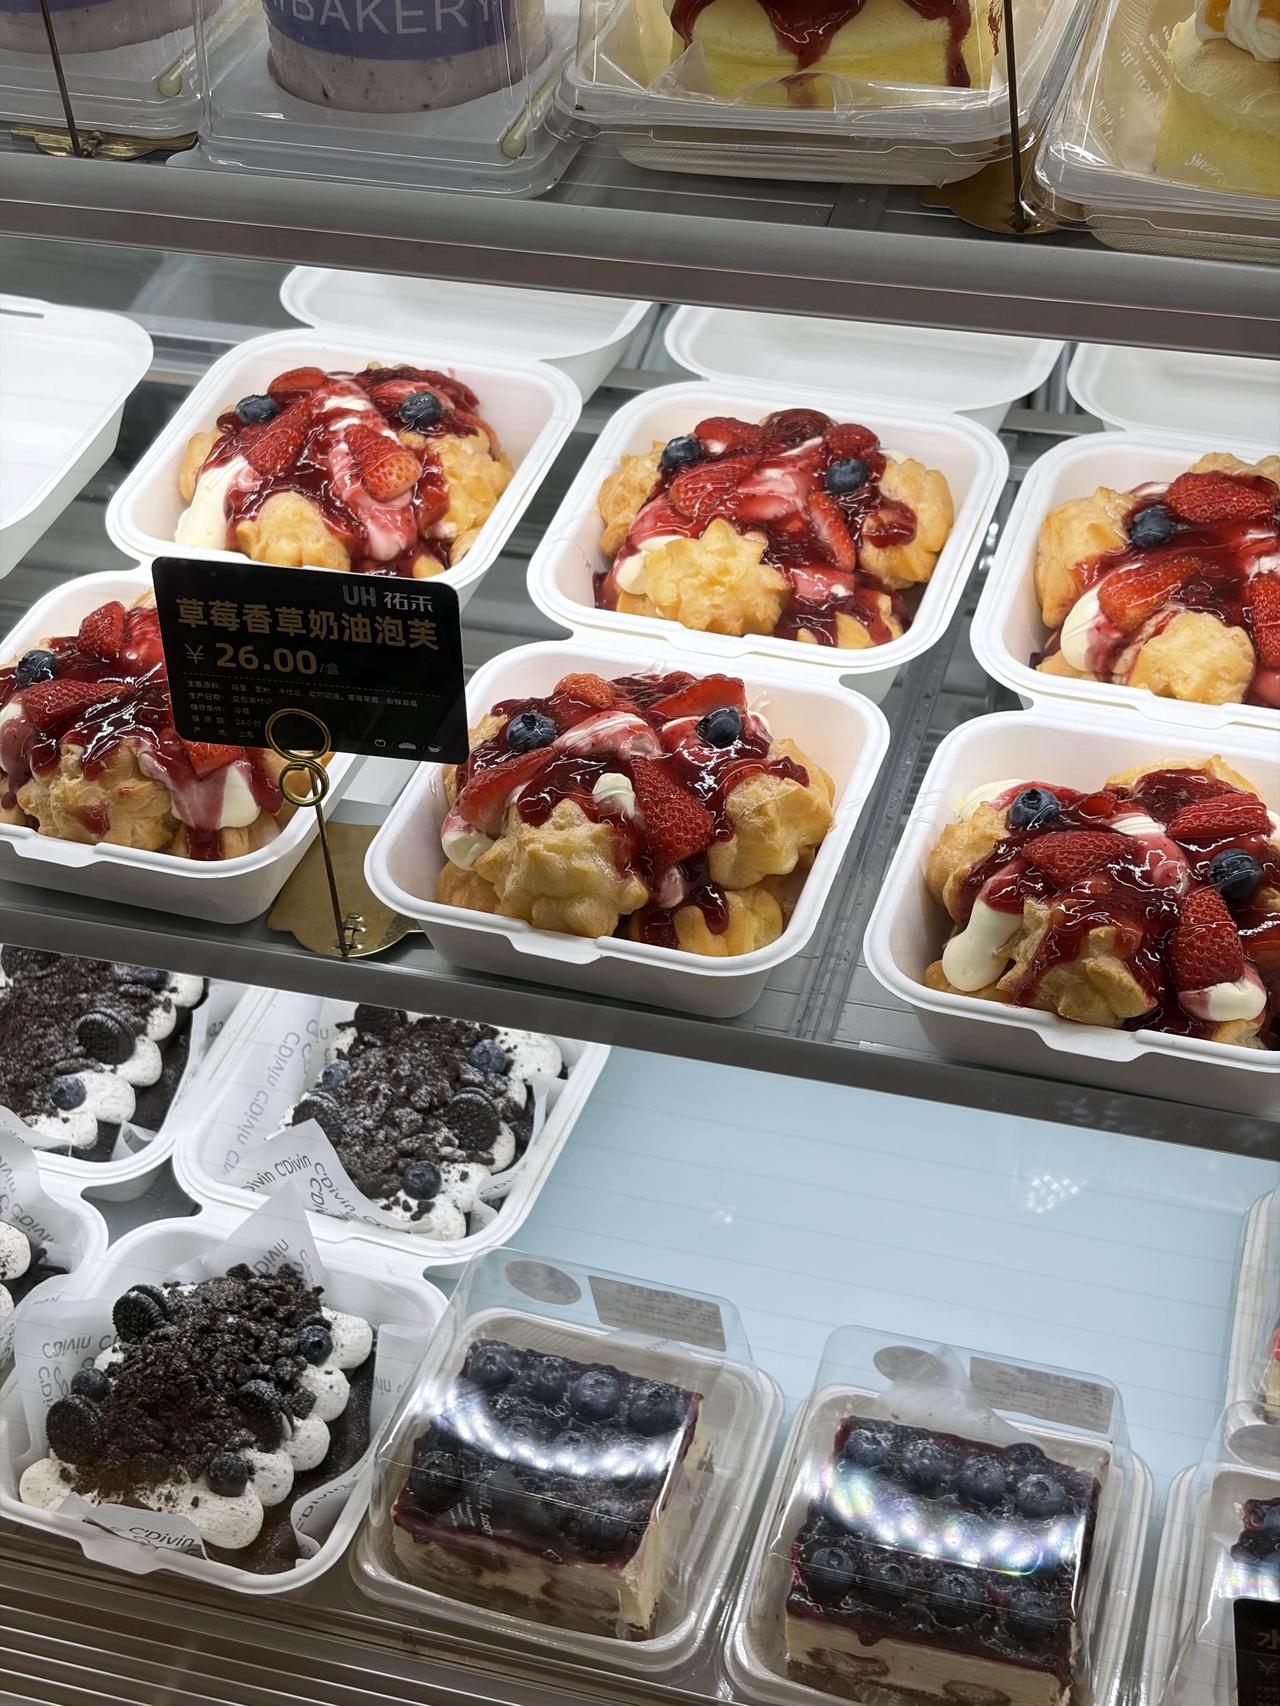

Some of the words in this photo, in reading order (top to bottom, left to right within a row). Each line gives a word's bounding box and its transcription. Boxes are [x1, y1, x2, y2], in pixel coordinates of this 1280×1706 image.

[342, 585, 377, 608] UH
[175, 597, 440, 650] 草莓香草奶油泡芙
[274, 1153, 312, 1177] C'Divin
[129, 1527, 195, 1547] C'Divin
